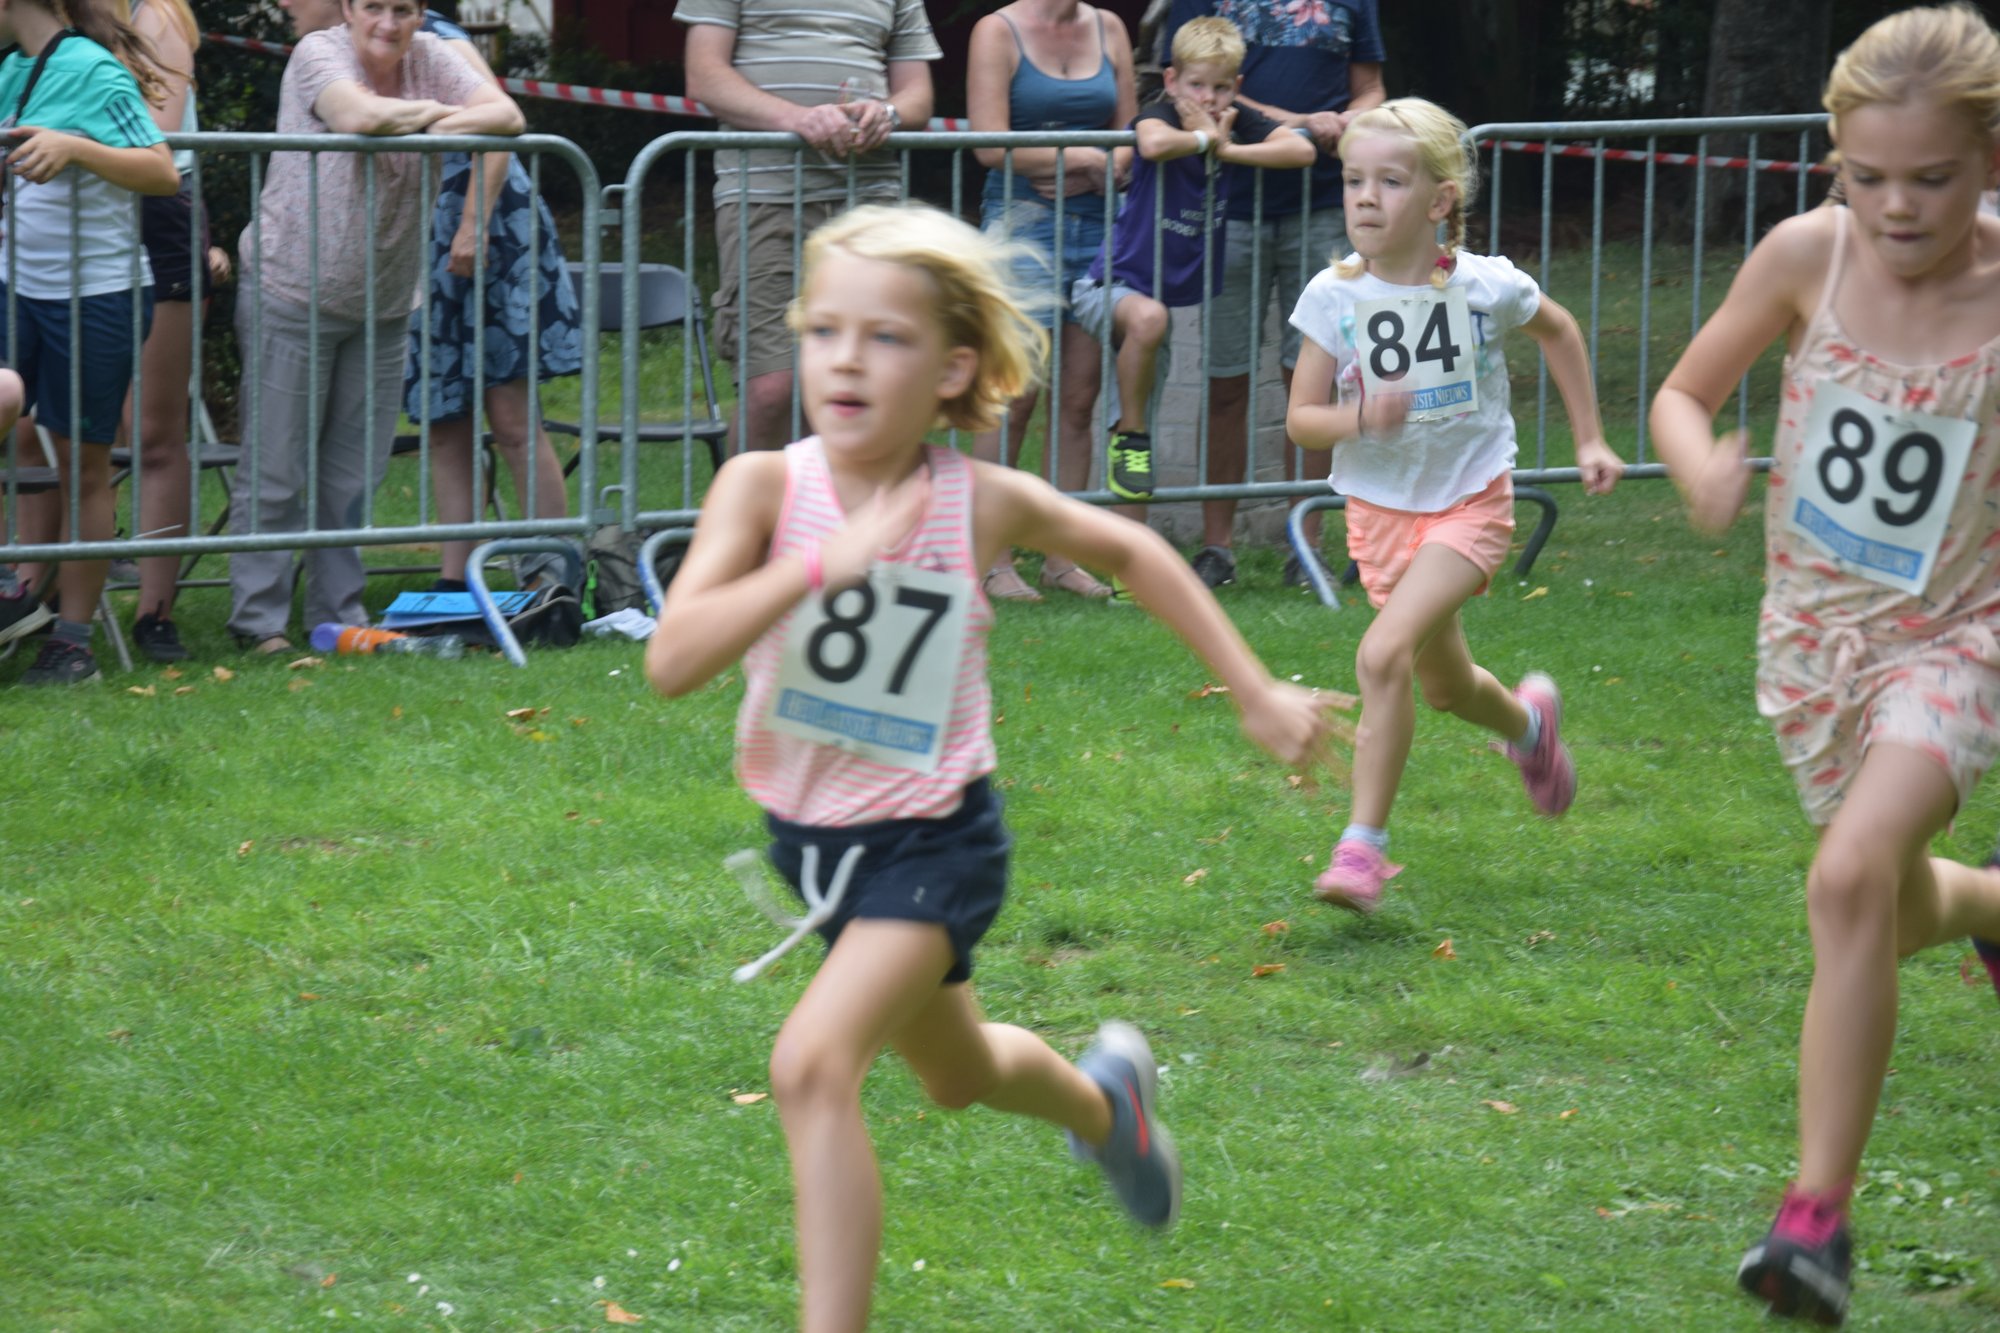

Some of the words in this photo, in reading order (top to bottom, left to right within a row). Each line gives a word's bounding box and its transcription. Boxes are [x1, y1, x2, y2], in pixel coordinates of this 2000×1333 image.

[1367, 301, 1461, 381] 84
[1817, 407, 1944, 527] 89
[805, 579, 953, 695] 87
